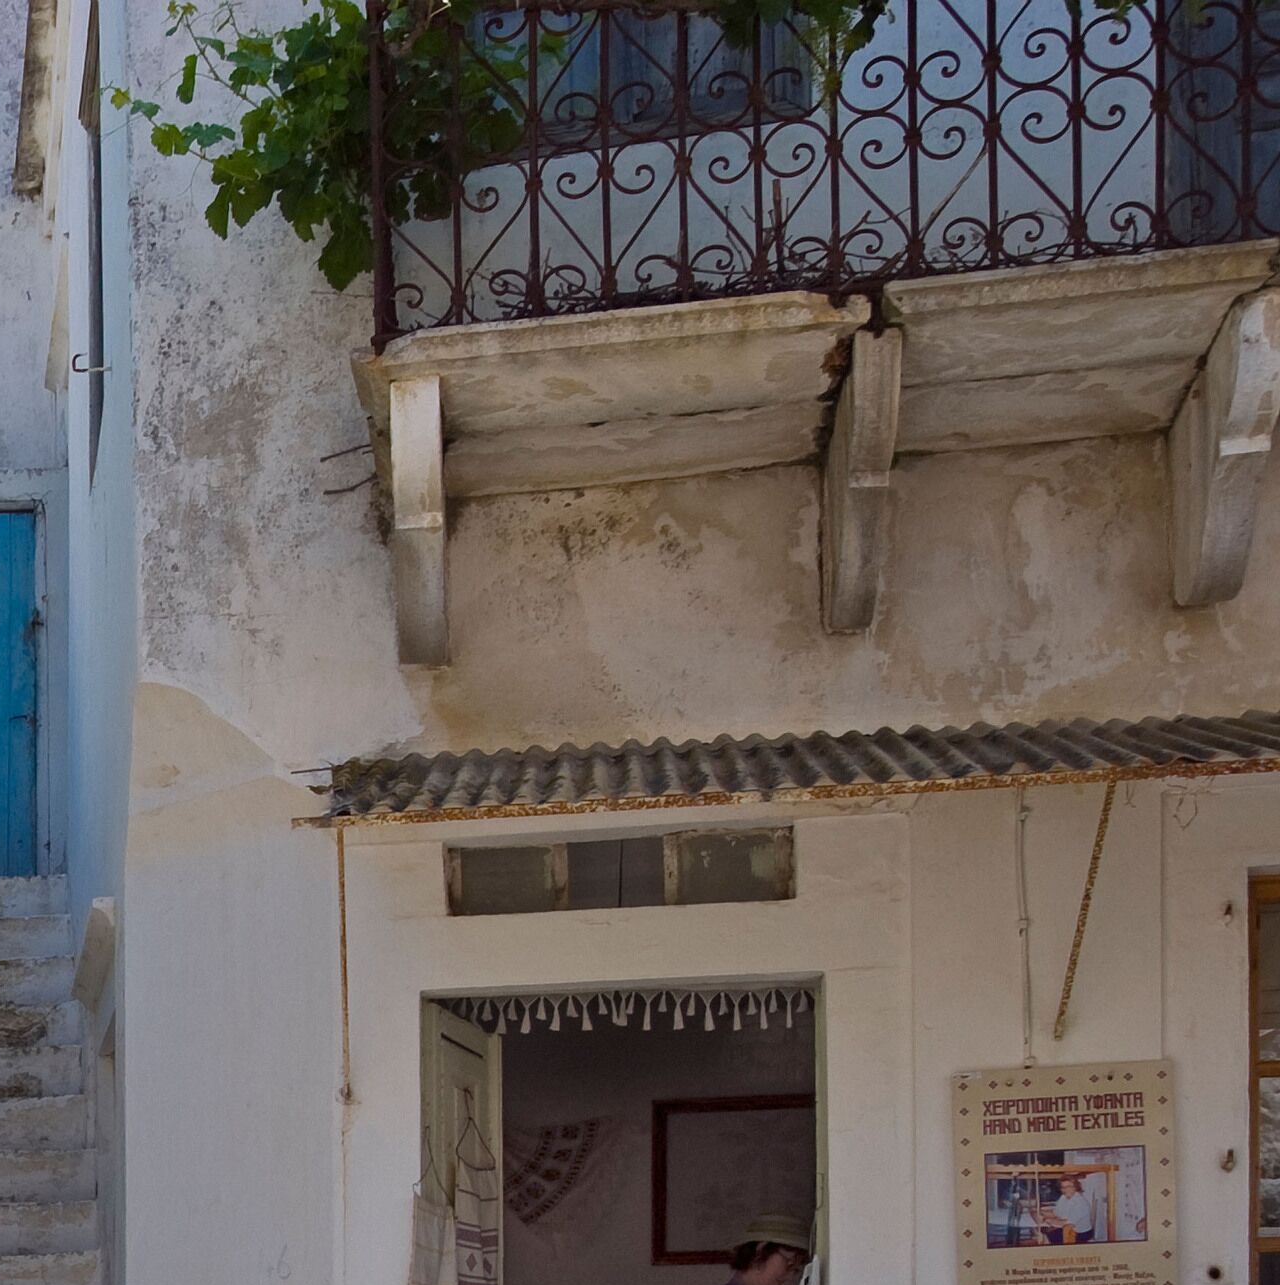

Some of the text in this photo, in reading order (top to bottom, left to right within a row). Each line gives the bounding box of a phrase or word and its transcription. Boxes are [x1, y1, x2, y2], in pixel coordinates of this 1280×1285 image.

[983, 1092, 1143, 1116] ΧΕΙΡΟΠΟΙΗΤΑ ΥΦΑΝΤΑ
[983, 1111, 1144, 1135] HAND MADE TEXTILES
